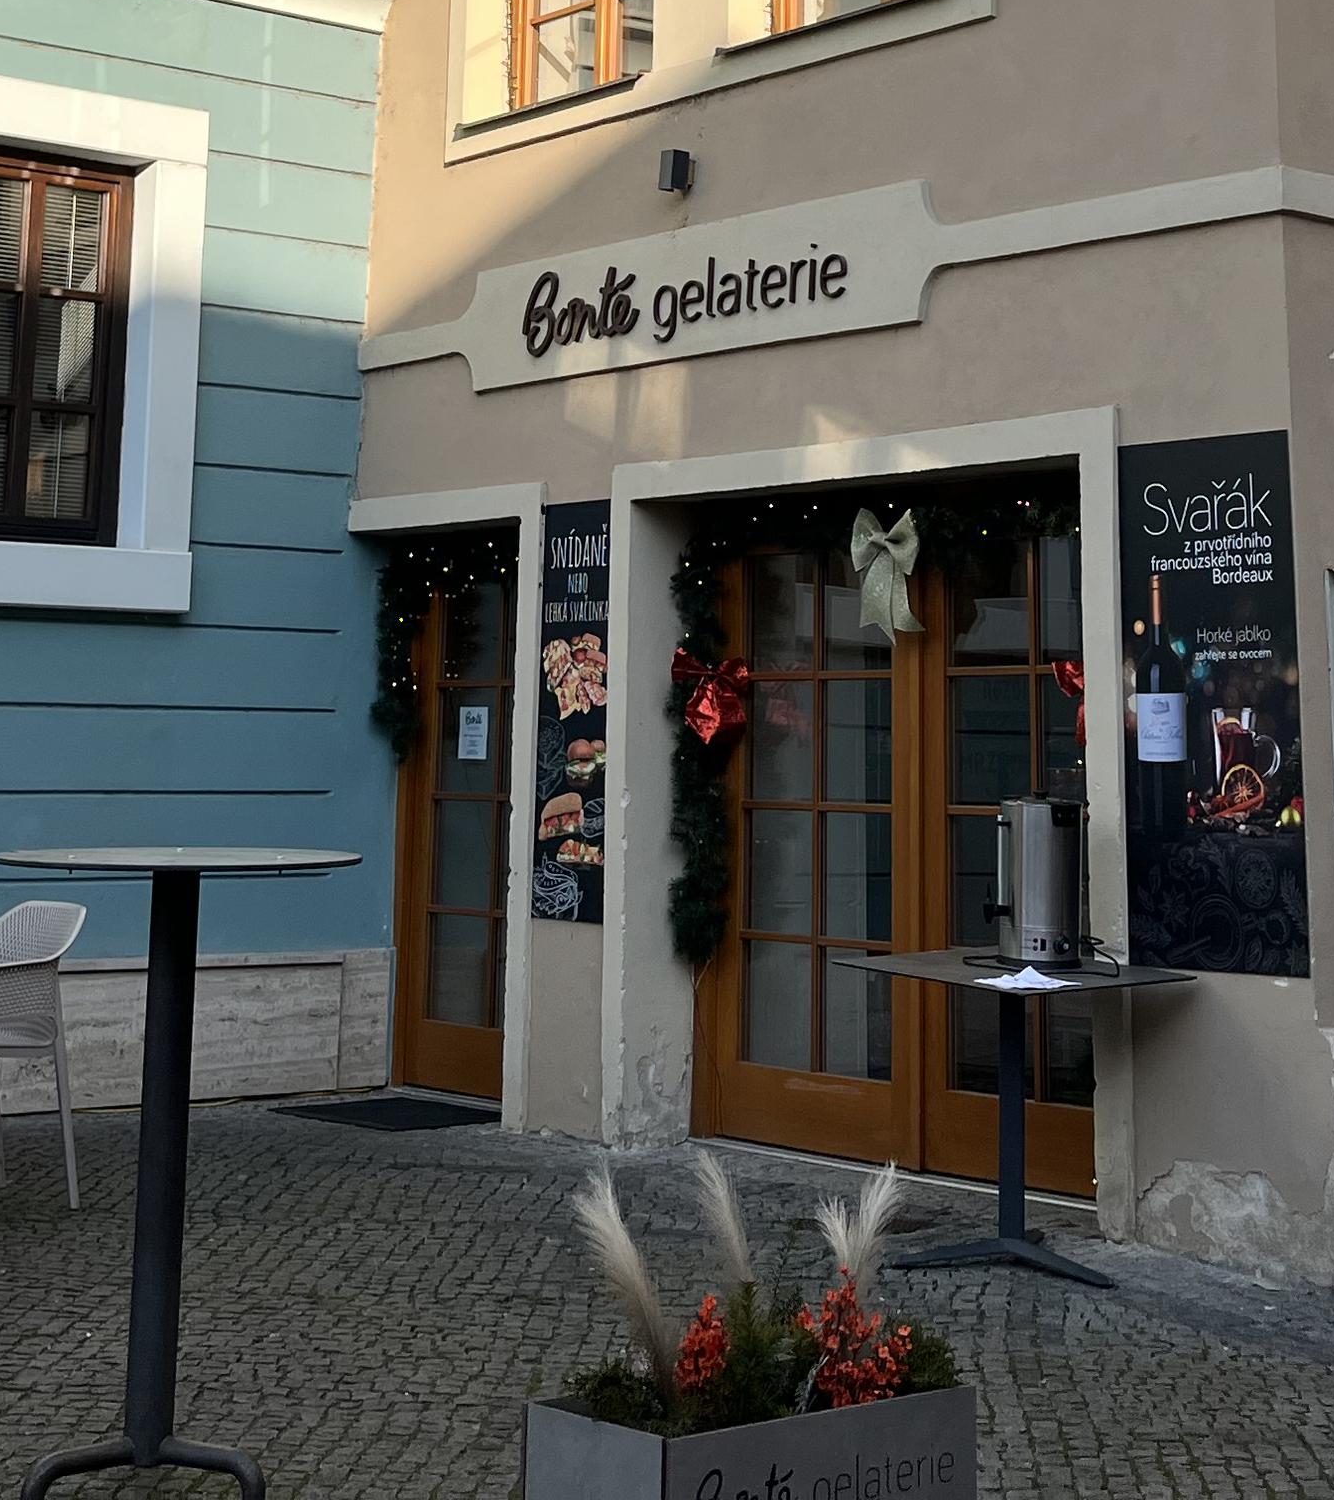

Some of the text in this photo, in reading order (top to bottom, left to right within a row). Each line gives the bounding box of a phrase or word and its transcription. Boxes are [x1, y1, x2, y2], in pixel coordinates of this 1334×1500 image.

[521, 243, 848, 358] Bonté gelaterie
[1143, 473, 1273, 536] Svařák
[550, 523, 608, 570] SNÍDANĚ
[1184, 532, 1272, 555] z prvotřídního
[1151, 550, 1273, 571] francouzského vína
[1212, 567, 1274, 585] Bordeaux
[1196, 624, 1272, 646] Horké jablko
[1228, 650, 1238, 660] se
